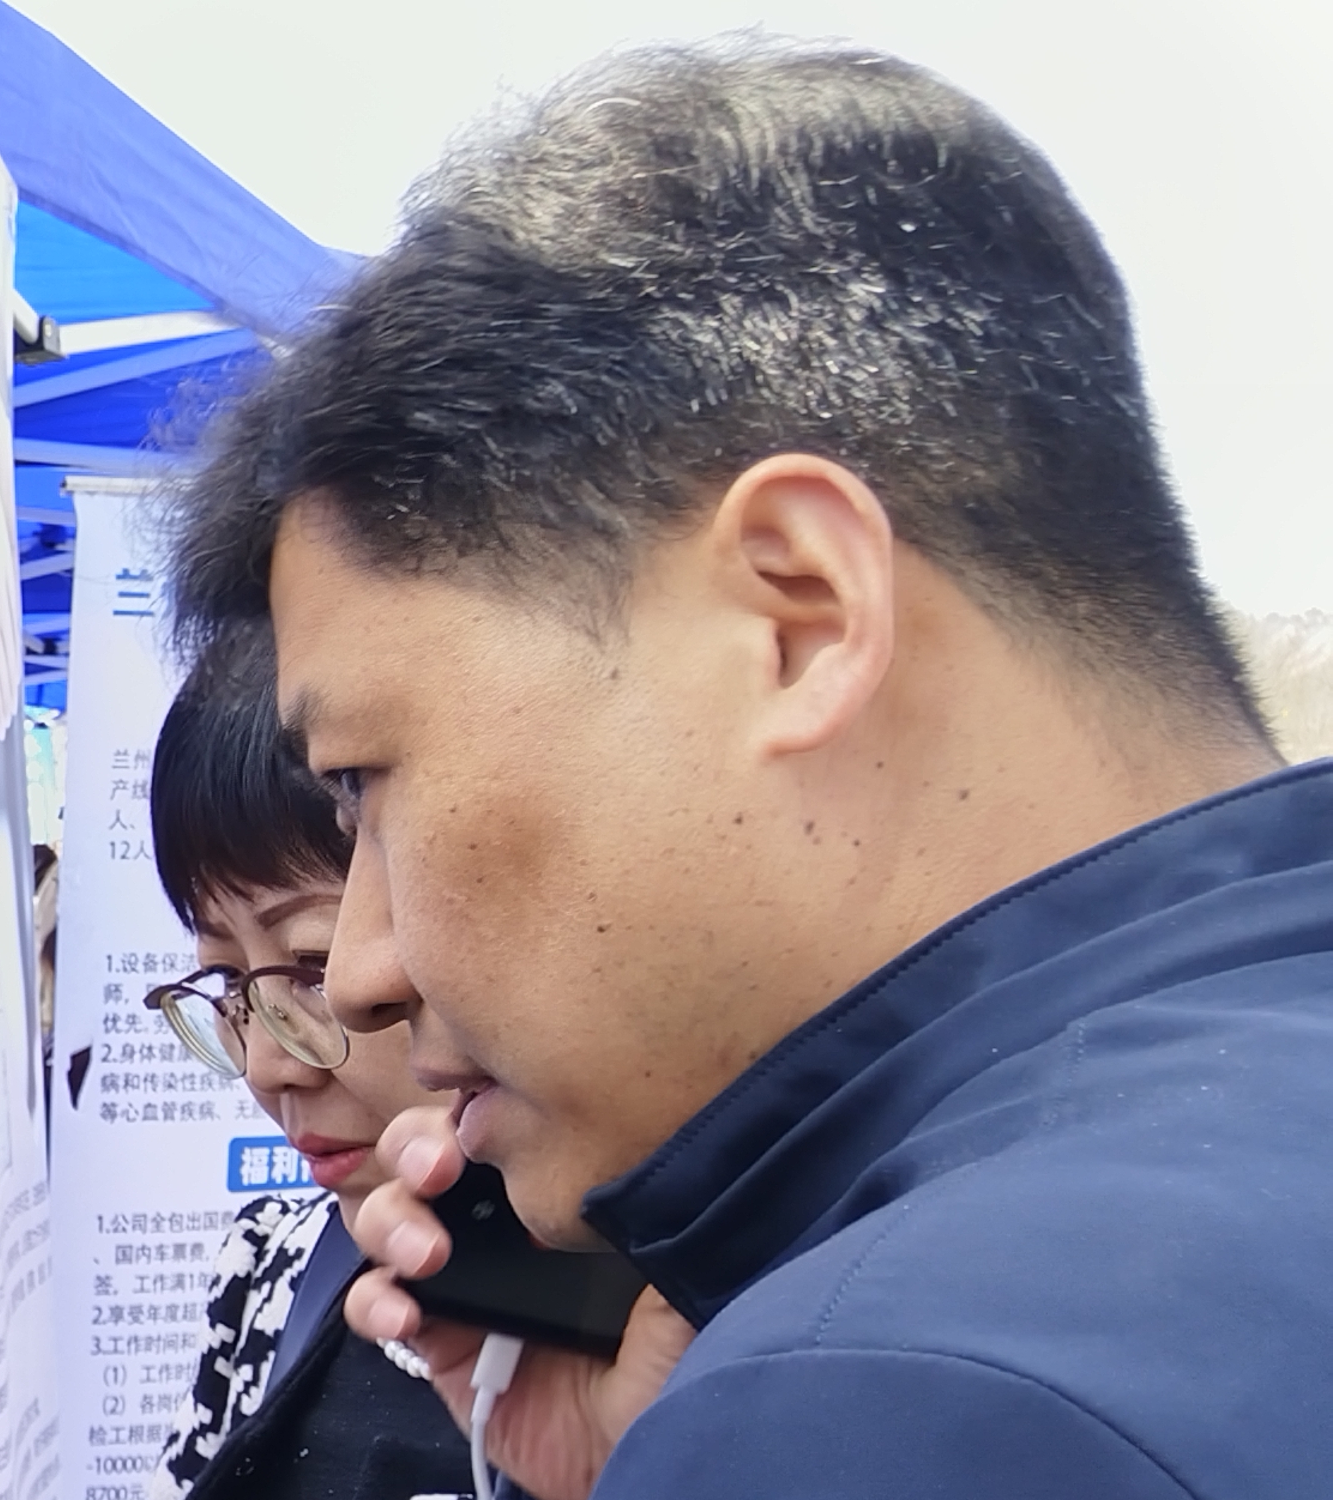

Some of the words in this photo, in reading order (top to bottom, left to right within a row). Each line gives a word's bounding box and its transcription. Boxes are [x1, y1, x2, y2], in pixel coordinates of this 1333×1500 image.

[91, 1302, 206, 1326] 2.享受年度超
[103, 1361, 199, 1387] （1）工作时
